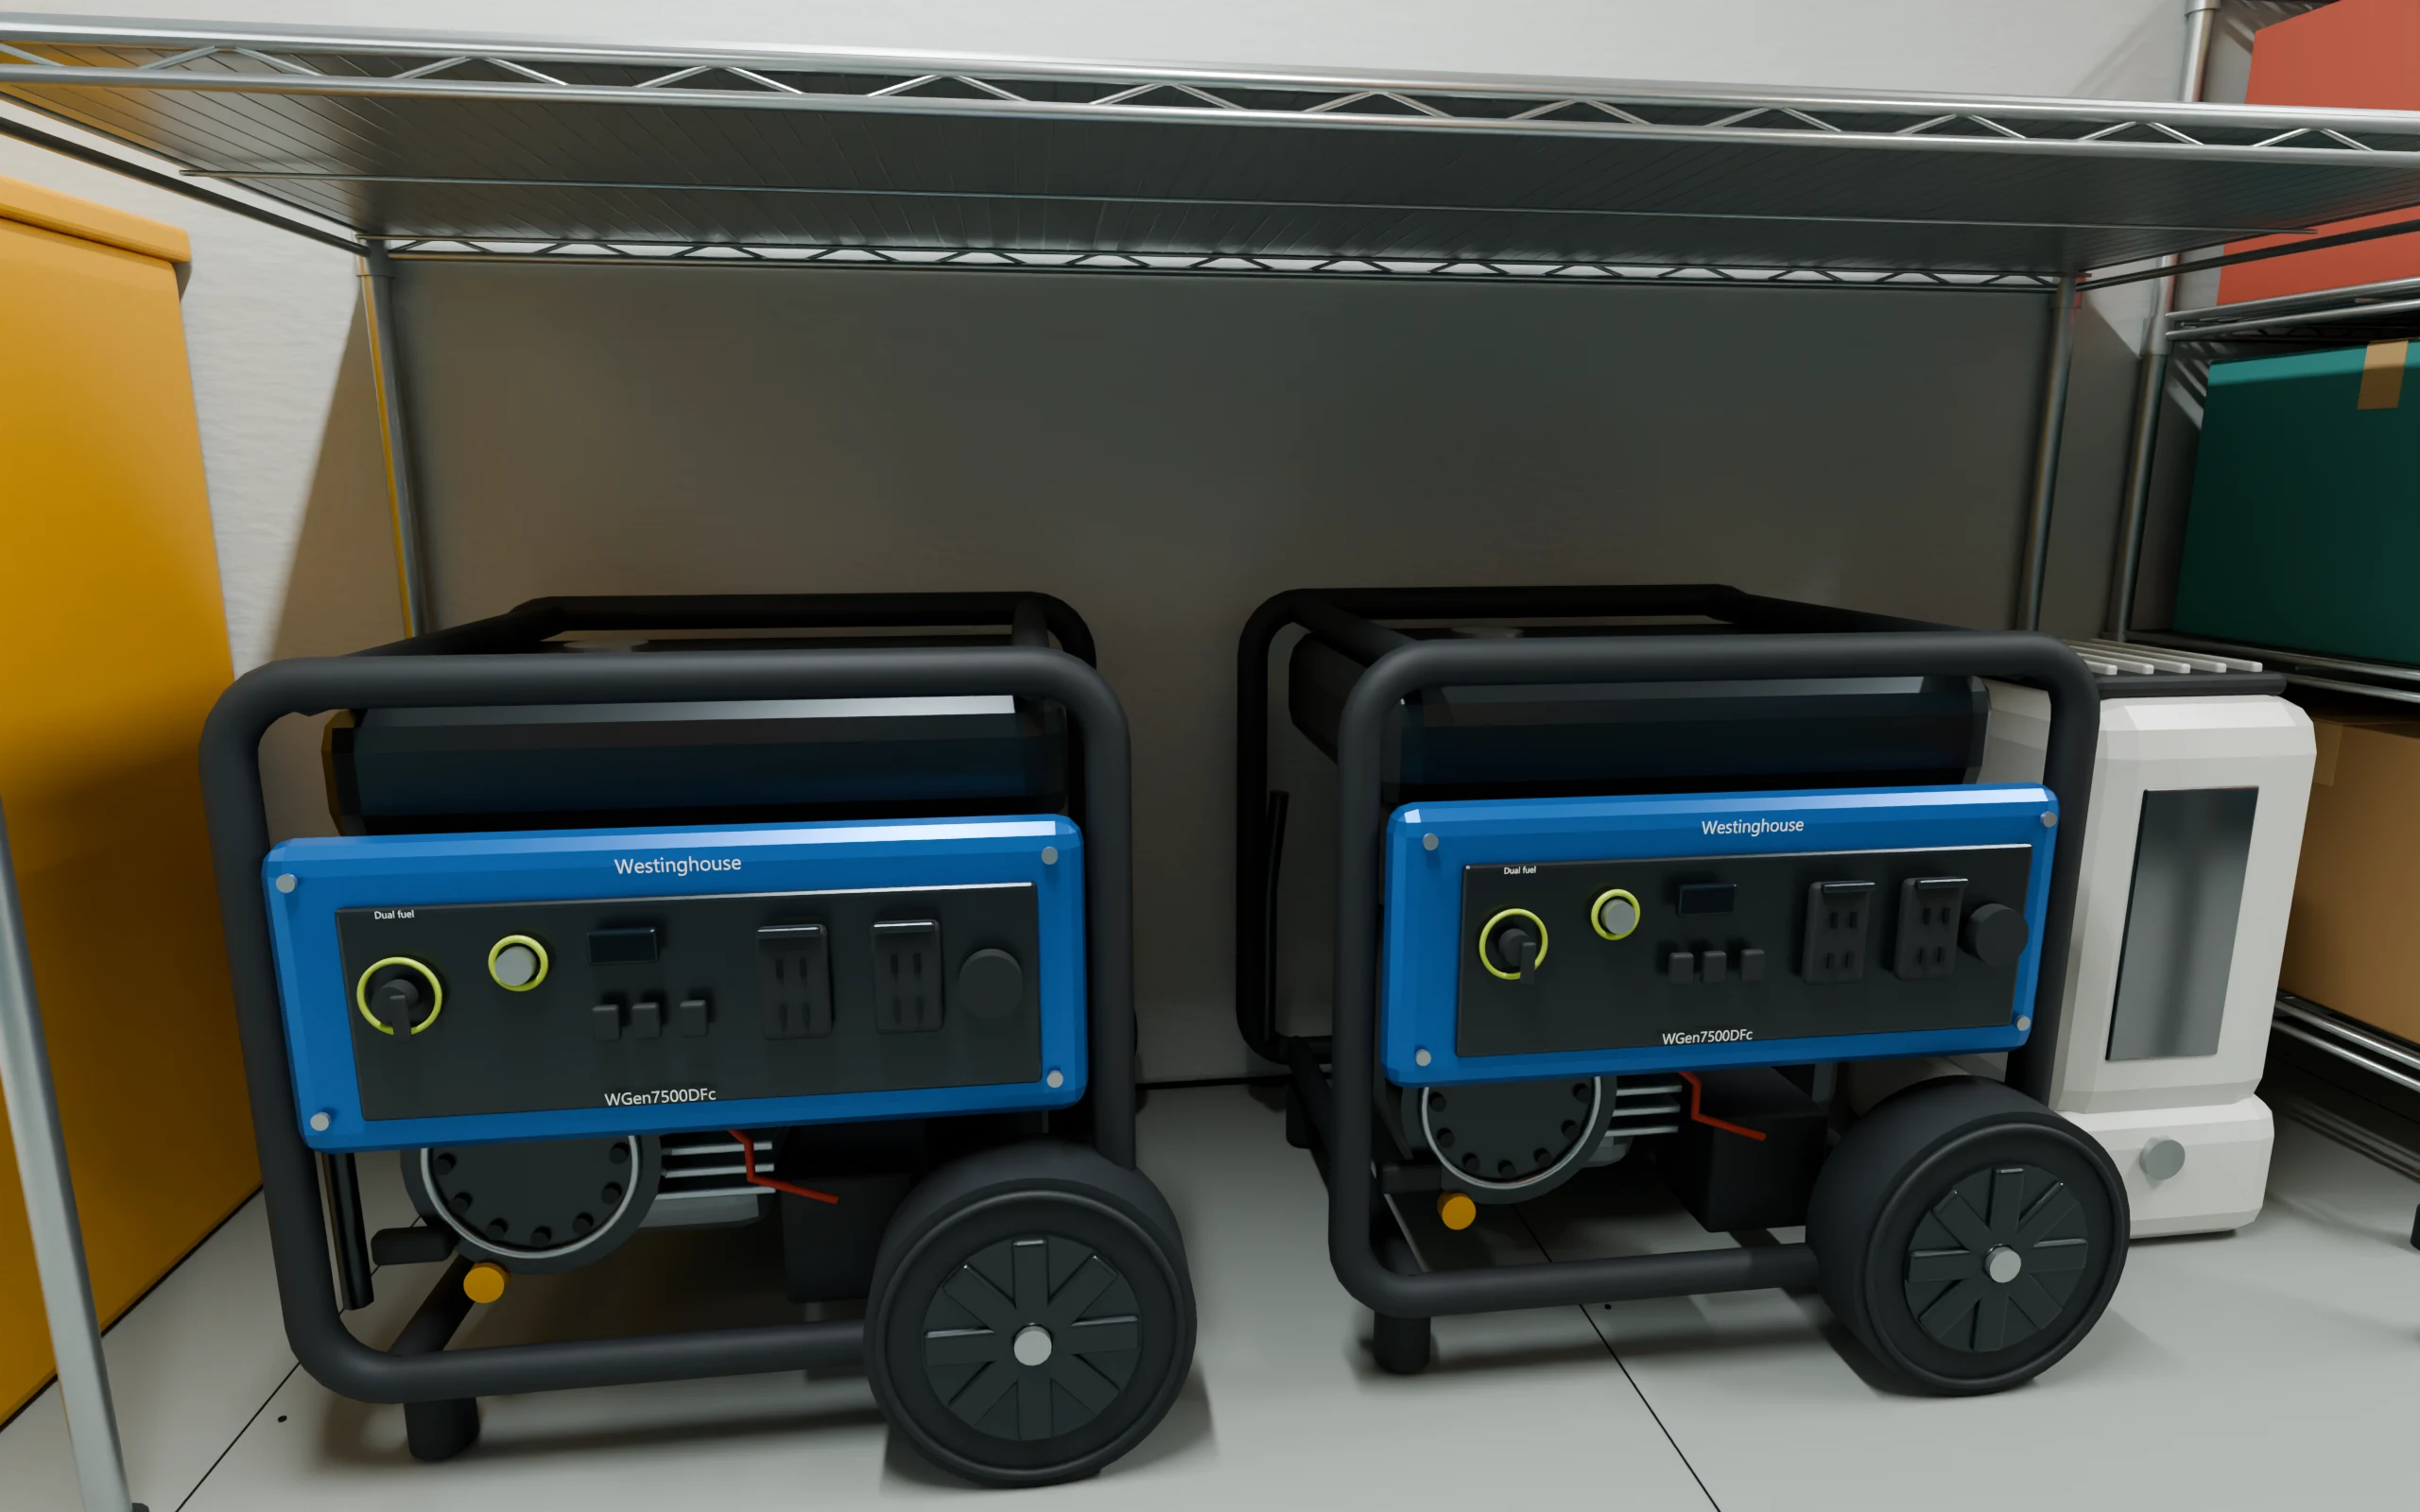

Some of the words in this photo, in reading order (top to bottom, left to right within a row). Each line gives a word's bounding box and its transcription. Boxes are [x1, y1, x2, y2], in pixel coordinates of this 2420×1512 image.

[1701, 817, 1805, 837] Westinghouse
[614, 856, 742, 877] Westinghouse
[1503, 866, 1521, 875] Dual
[1522, 865, 1537, 874] fuel
[373, 910, 395, 920] Dual
[396, 909, 415, 919] fuel
[1662, 1028, 1754, 1045] WGen7500DFc
[603, 1088, 717, 1107] WGen7500DFc
